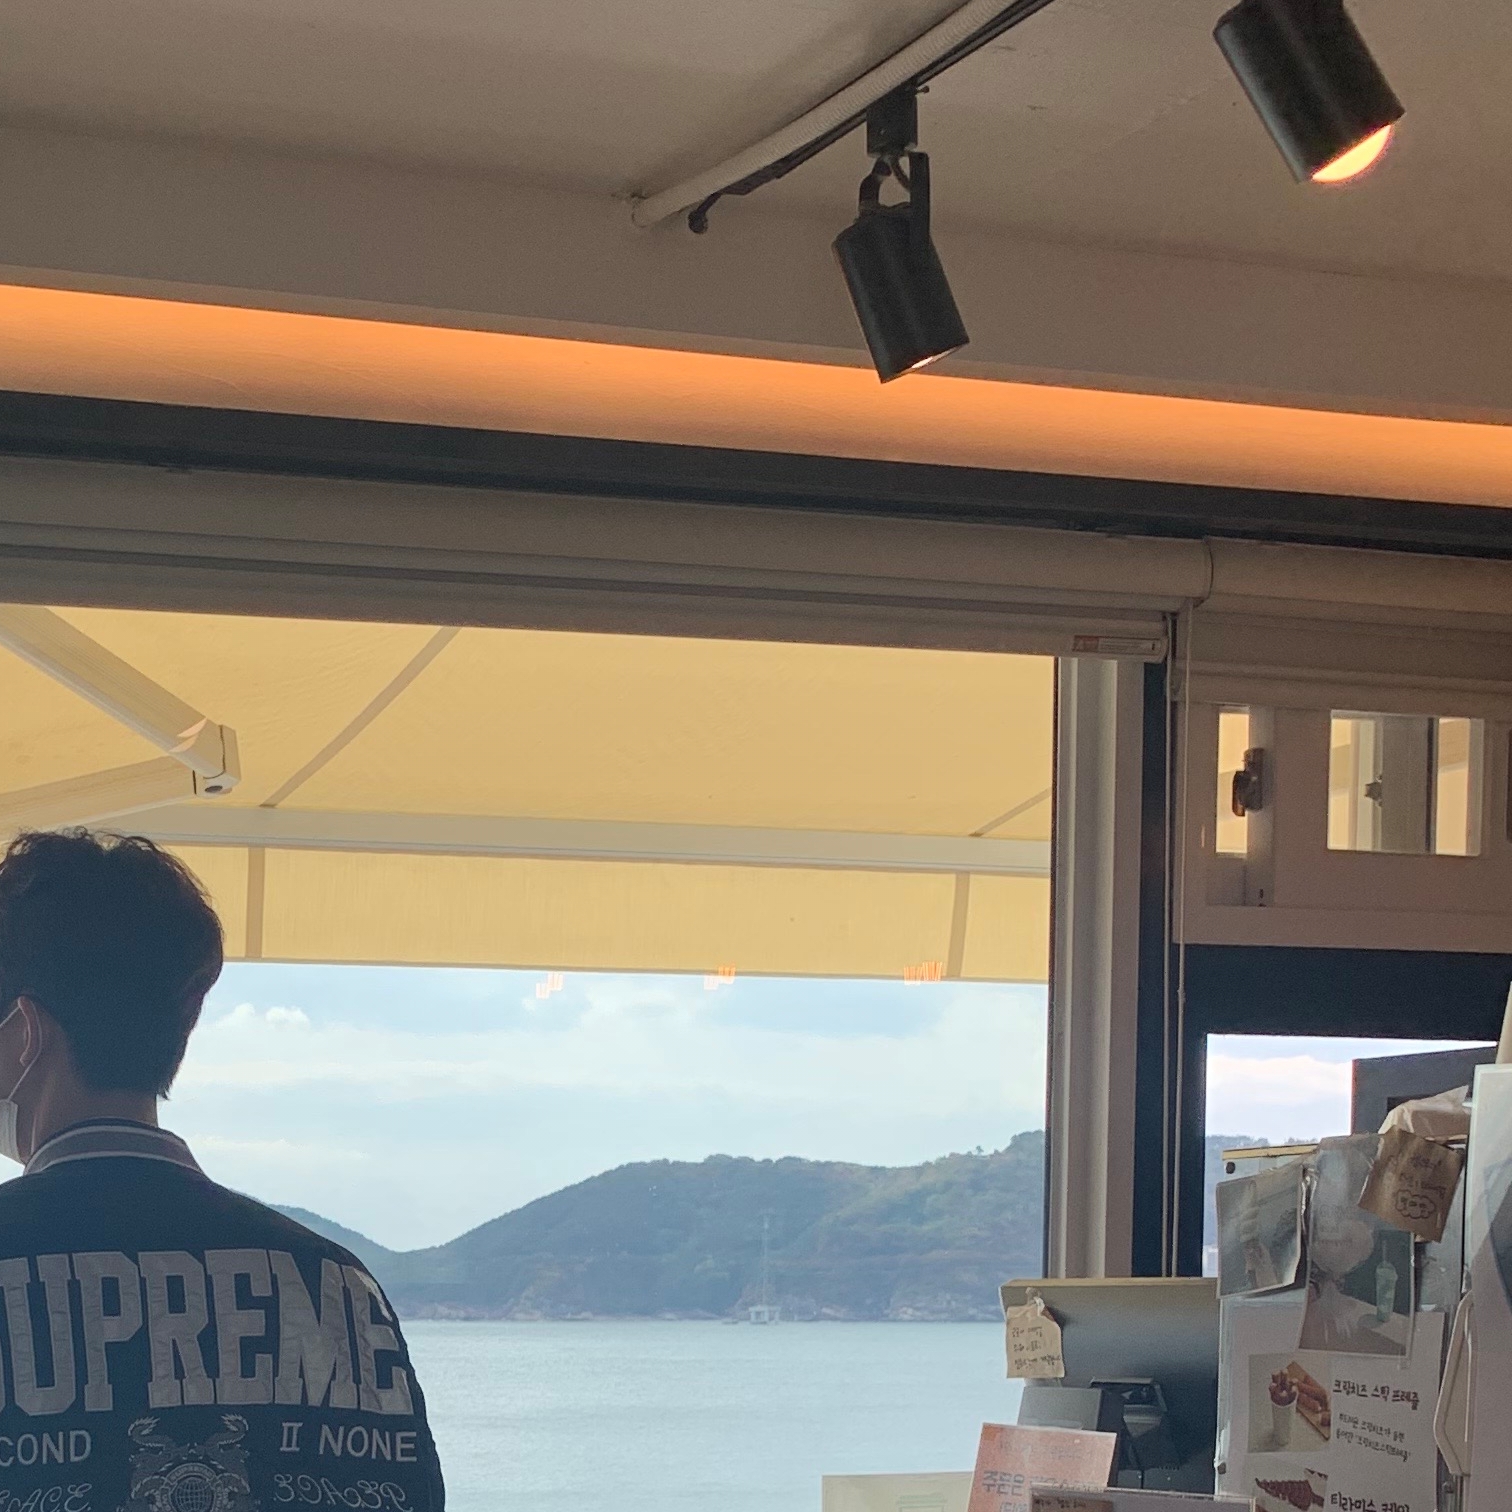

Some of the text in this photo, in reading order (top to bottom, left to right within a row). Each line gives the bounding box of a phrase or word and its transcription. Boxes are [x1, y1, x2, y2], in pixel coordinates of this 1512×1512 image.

[1333, 1379, 1368, 1398] 크림치즈
[1371, 1386, 1390, 1402] 스틱
[319, 1424, 418, 1462] NONE
